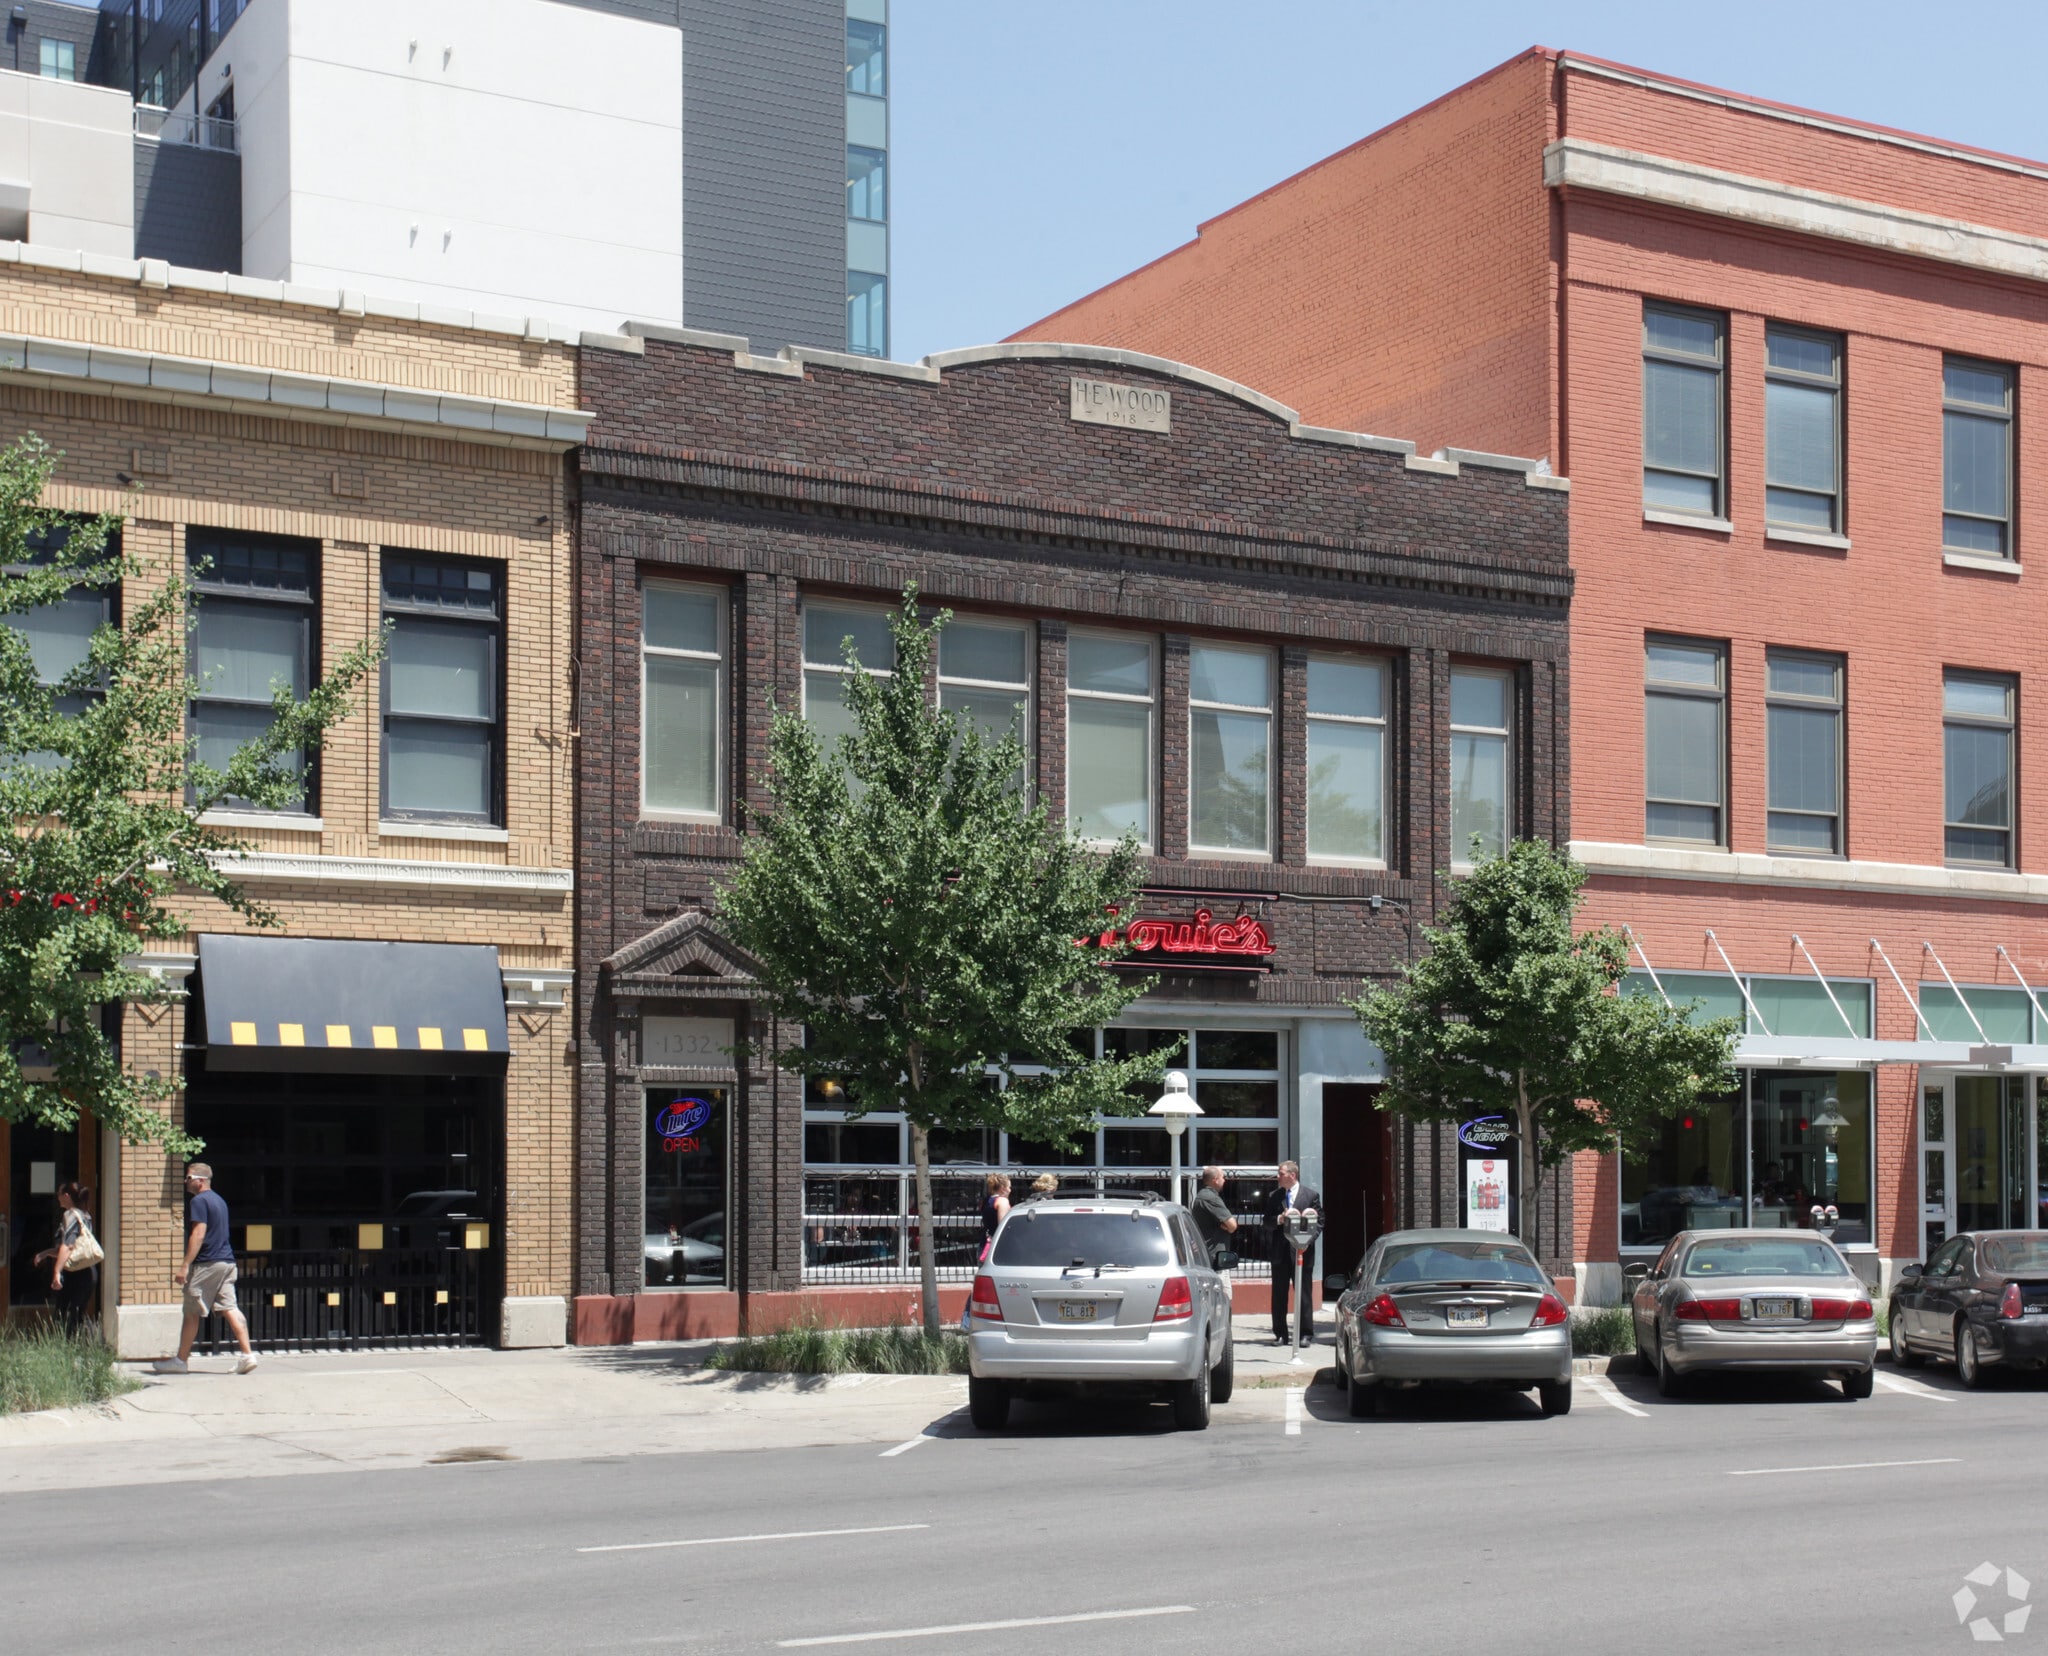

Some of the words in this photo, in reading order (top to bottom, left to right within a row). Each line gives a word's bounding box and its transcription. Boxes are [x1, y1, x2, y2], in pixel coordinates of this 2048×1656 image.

[1106, 411, 1137, 425] 1918
[664, 1034, 713, 1054] 1332
[1465, 1132, 1508, 1142] LIGHT
[663, 1137, 699, 1153] OPEN
